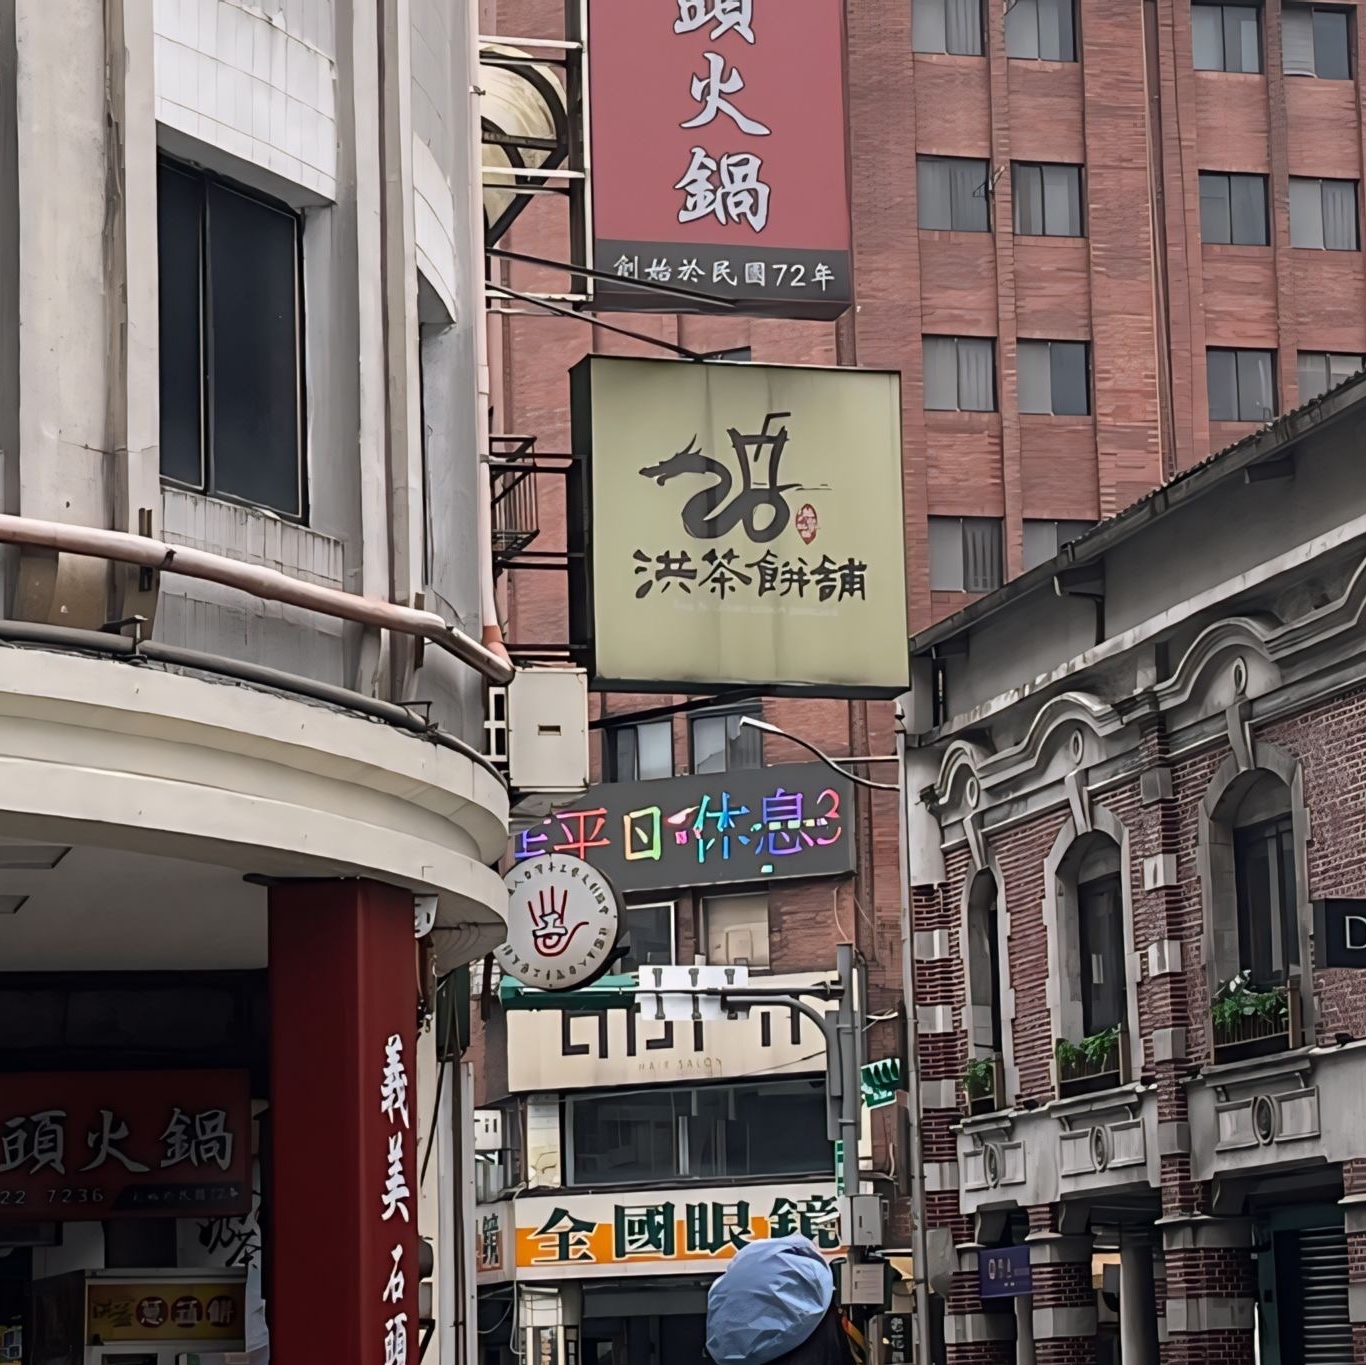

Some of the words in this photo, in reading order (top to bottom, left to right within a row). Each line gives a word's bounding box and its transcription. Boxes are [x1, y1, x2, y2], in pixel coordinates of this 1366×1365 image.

[613, 254, 836, 292] 創始於民國72年
[531, 1195, 843, 1264] 全國眼鏡
